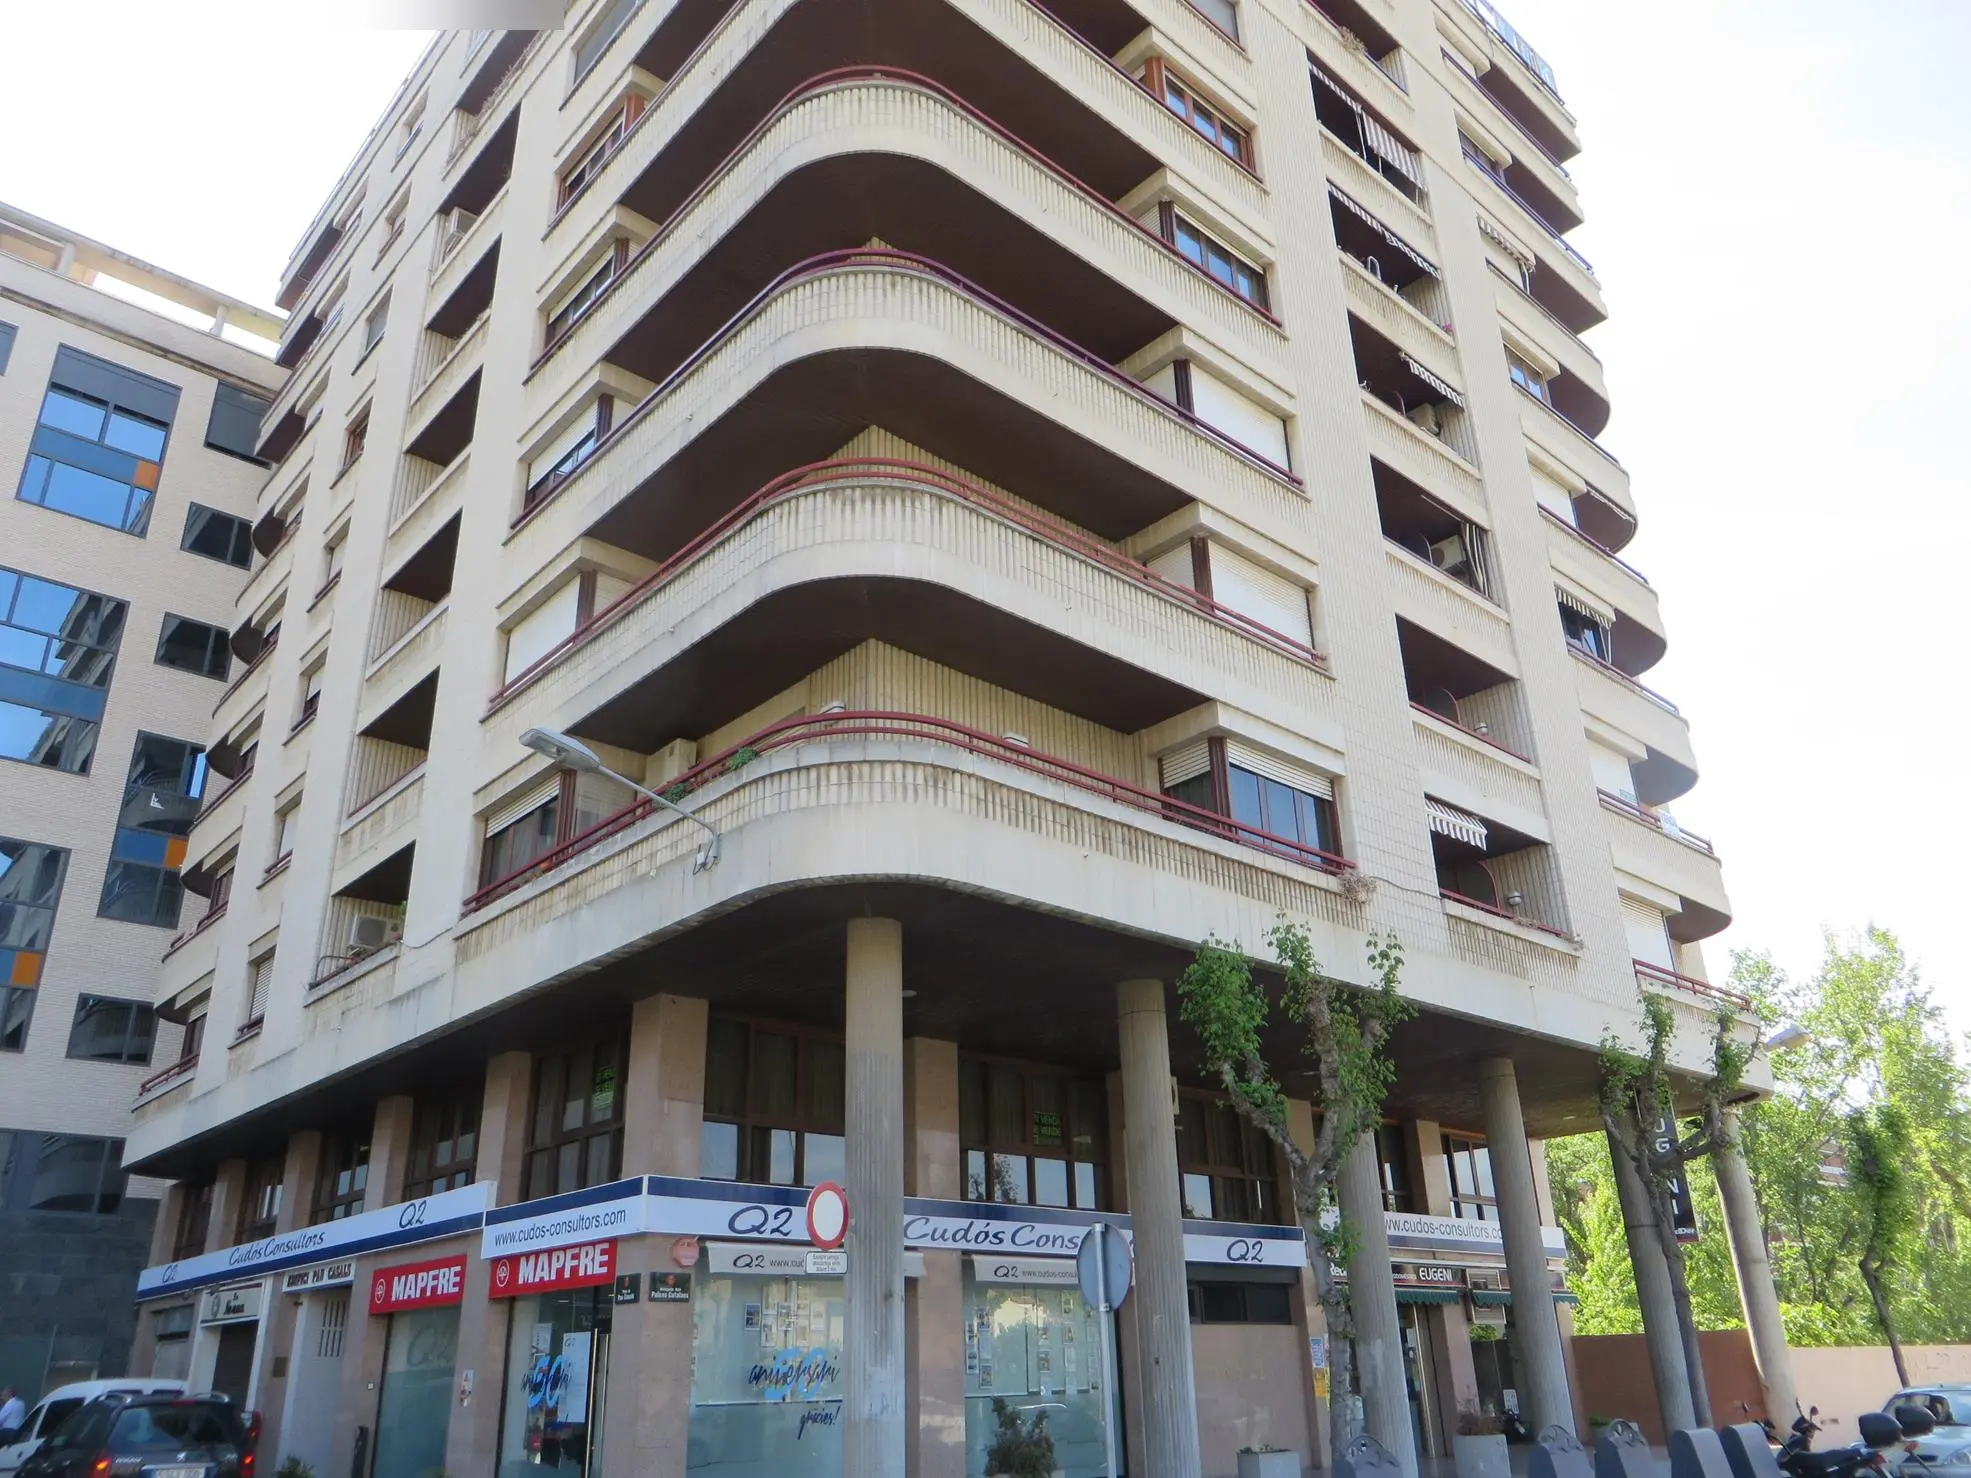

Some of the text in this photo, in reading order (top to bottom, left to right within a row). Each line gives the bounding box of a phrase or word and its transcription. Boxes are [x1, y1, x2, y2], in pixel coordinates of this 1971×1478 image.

[399, 1200, 427, 1228] Q2
[495, 1209, 626, 1246] www.cudos-consultors.com
[728, 1205, 792, 1236] Q2
[904, 1217, 1080, 1249] Cudós Cons
[1384, 1218, 1502, 1240] ww.cudos-consultors.co
[229, 1231, 325, 1265] Cudós Consultors
[733, 1254, 764, 1268] Q2
[769, 1259, 804, 1268] www.cu
[1227, 1239, 1264, 1263] Q2
[518, 1242, 609, 1285] MAPFRE
[994, 1265, 1018, 1278] Q2
[1419, 1267, 1453, 1282] EUGENI
[391, 1266, 461, 1302] MAPFRE
